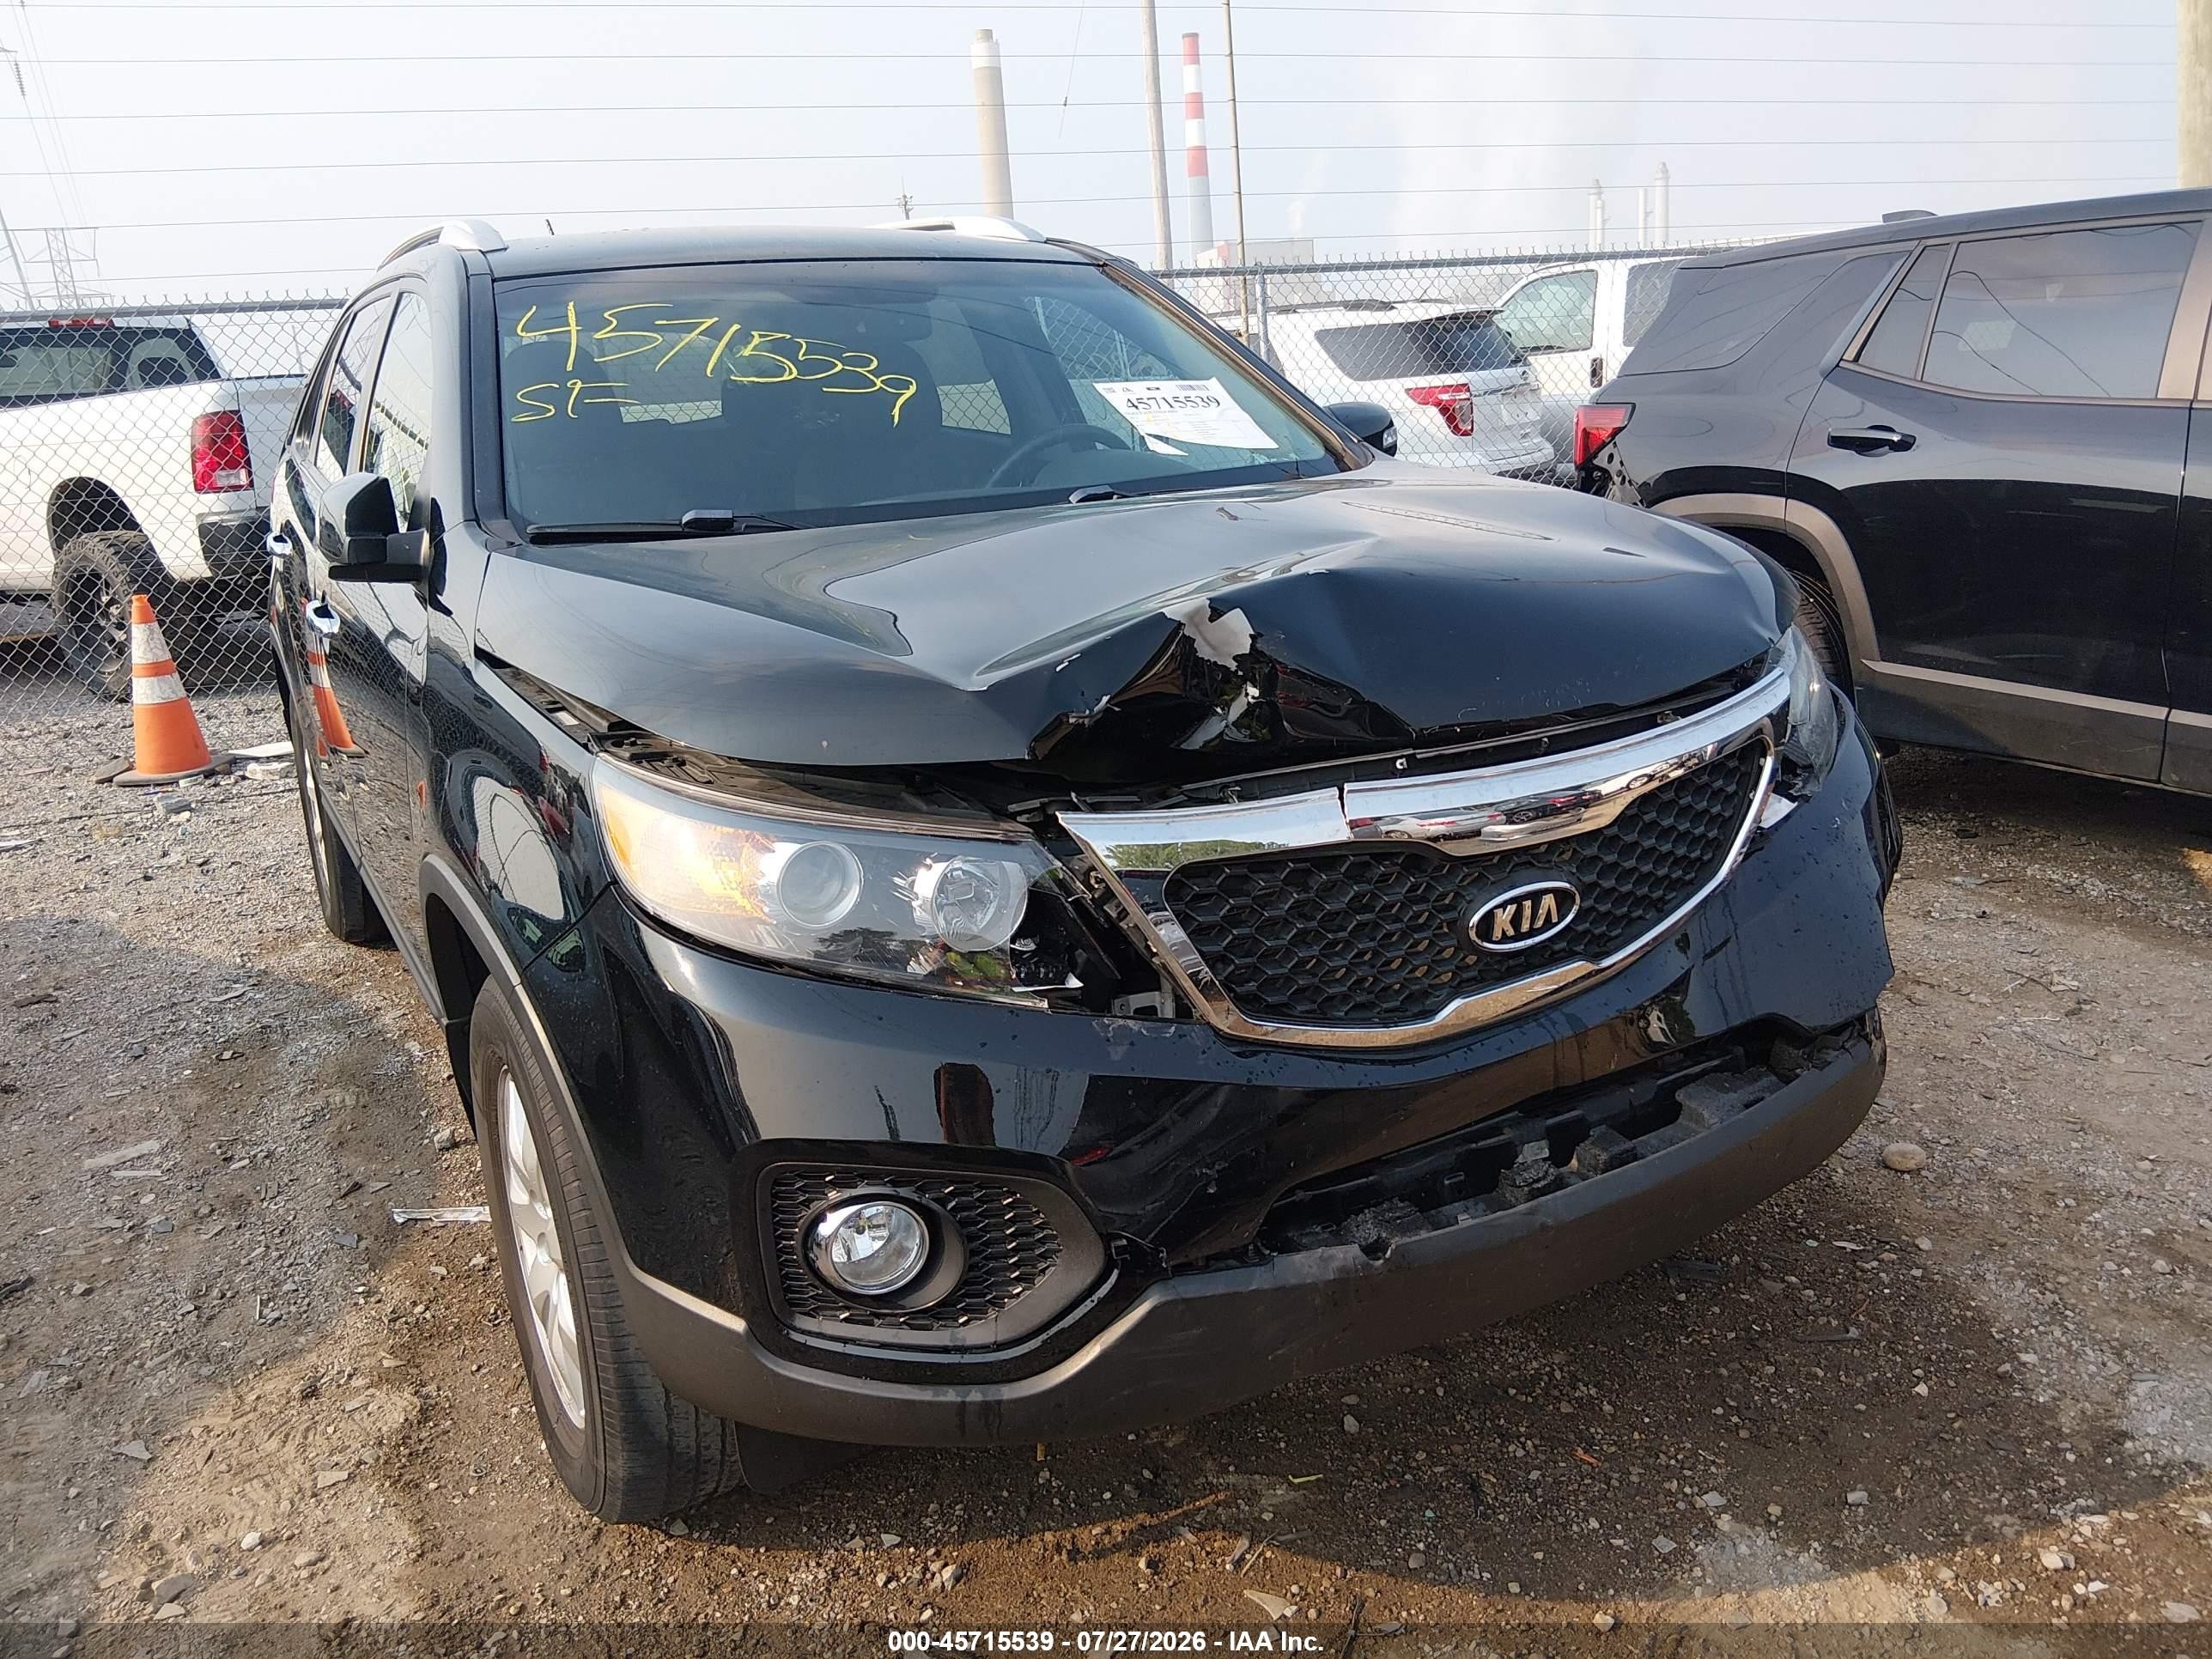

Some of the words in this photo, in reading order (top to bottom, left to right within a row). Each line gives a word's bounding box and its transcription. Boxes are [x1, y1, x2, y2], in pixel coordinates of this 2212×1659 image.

[516, 301, 917, 428] 45715539
[1126, 394, 1221, 410] 45715539
[1492, 893, 1559, 941] KIA
